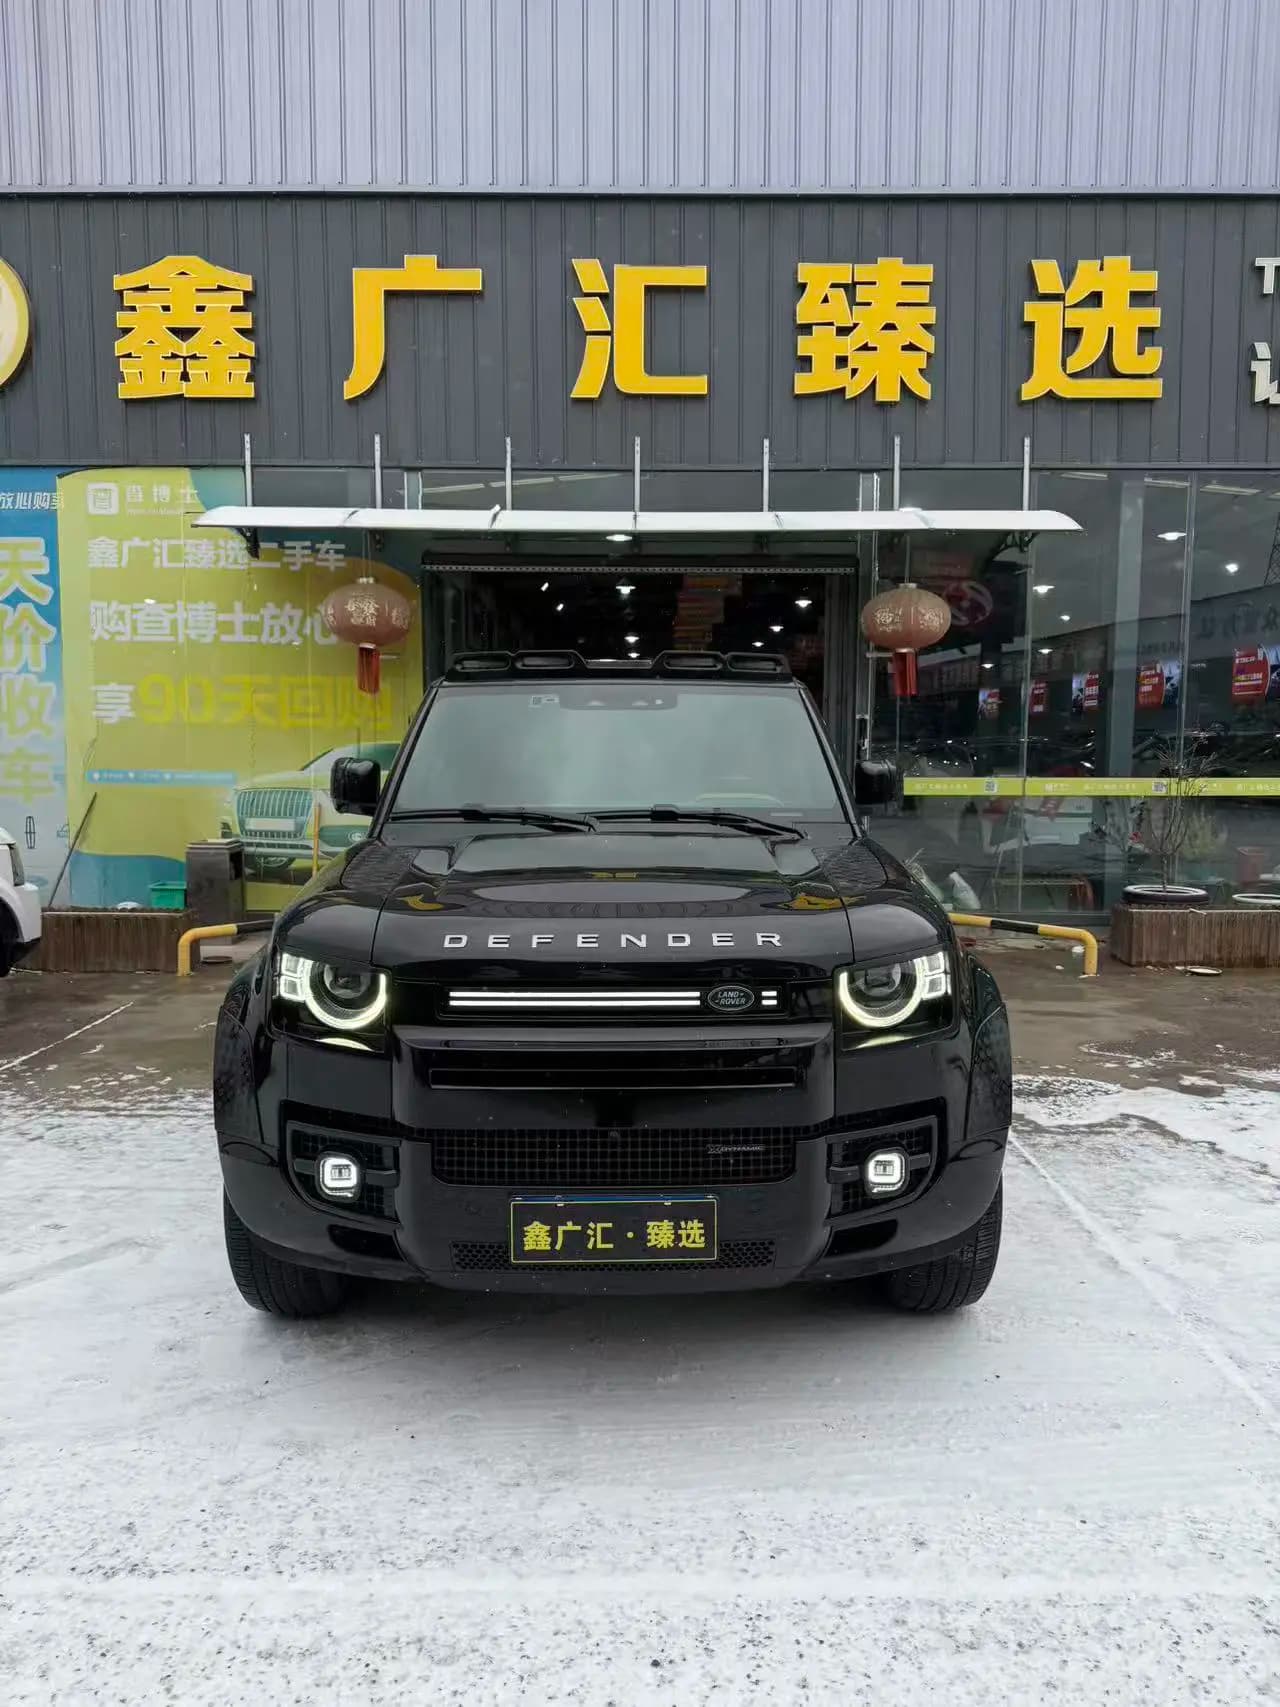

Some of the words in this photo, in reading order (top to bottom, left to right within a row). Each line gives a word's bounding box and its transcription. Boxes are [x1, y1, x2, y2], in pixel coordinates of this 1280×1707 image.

[113, 255, 1164, 402] 鑫广汇臻选
[88, 537, 347, 573] 鑫广汇臻选二手车
[443, 933, 783, 948] DEFENDER
[717, 991, 740, 999] LAND
[719, 998, 746, 1006] ROVER
[522, 1220, 707, 1252] 鑫广汇·臻选
